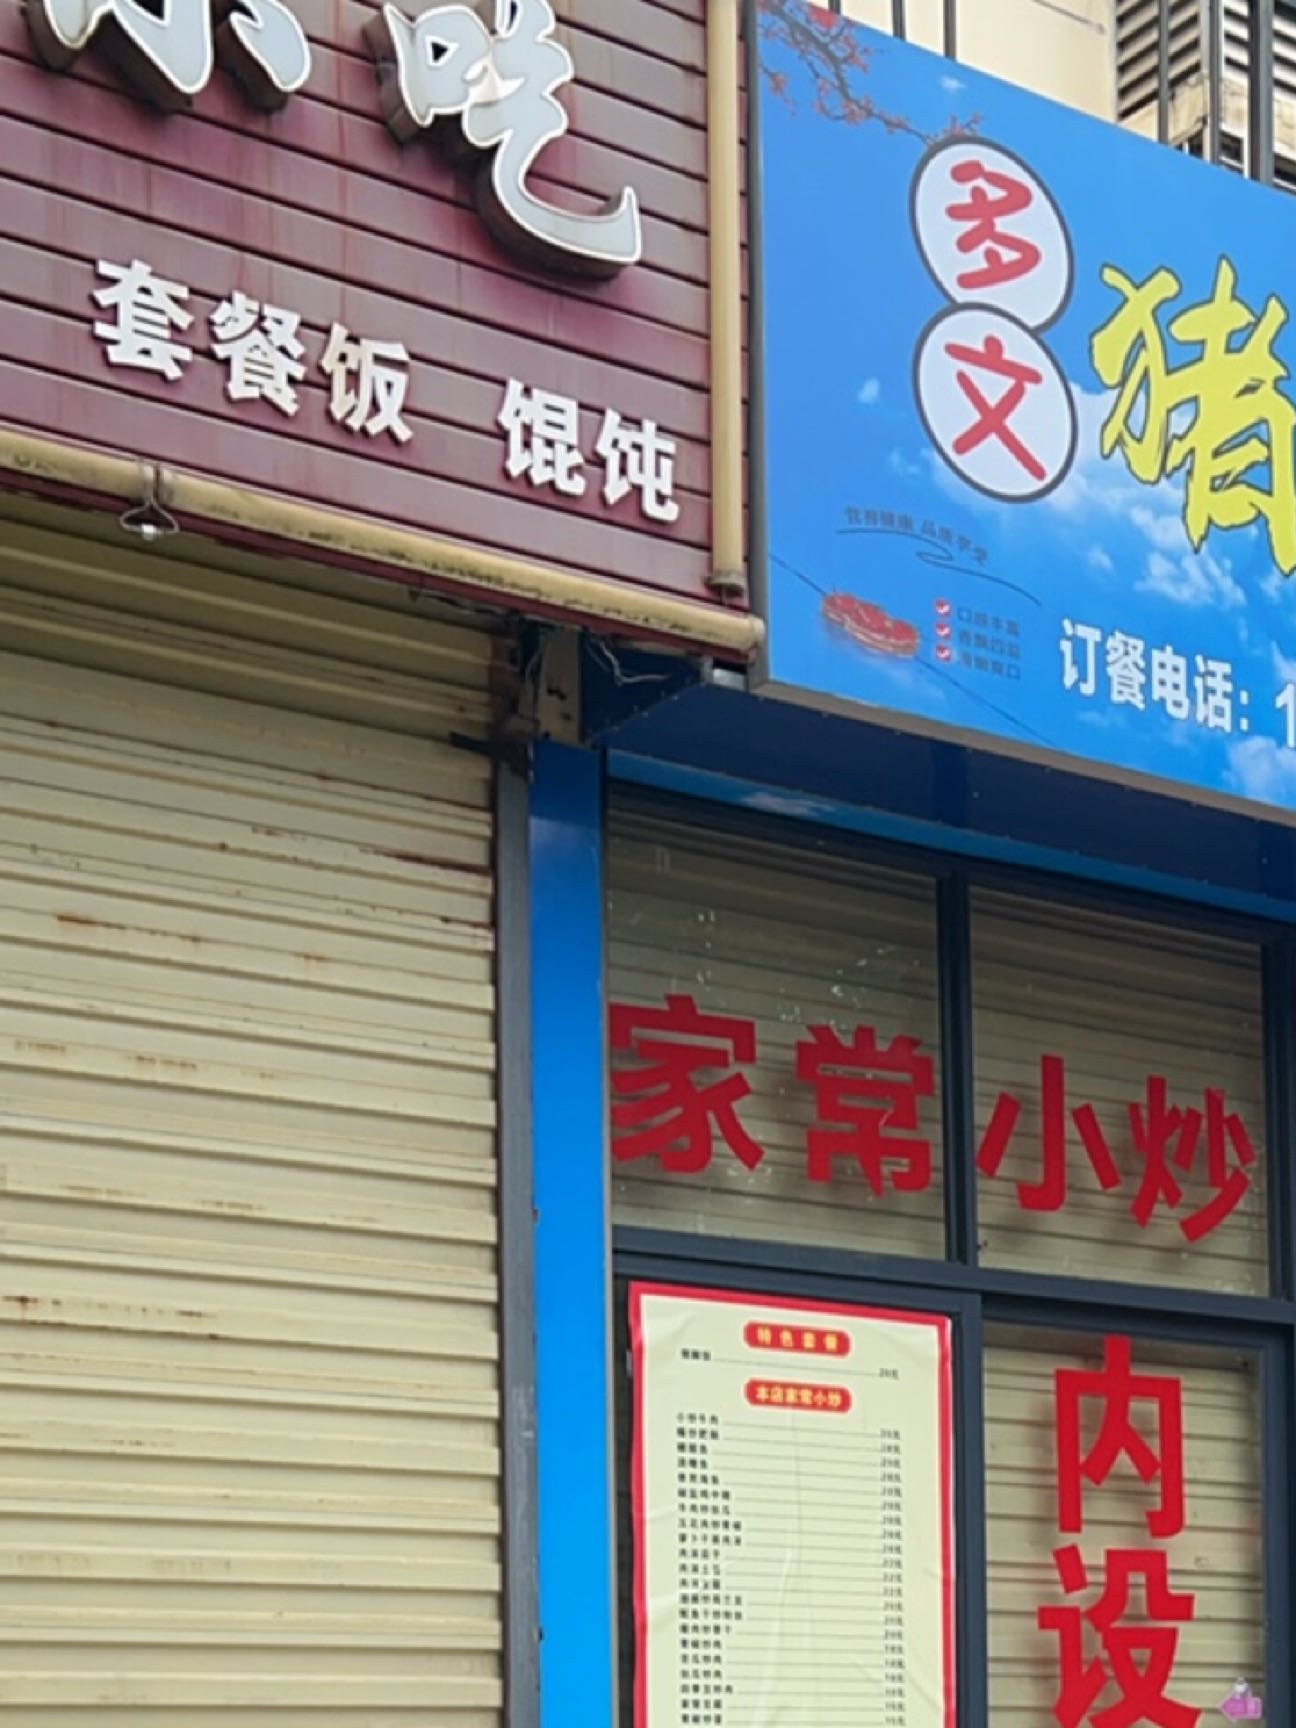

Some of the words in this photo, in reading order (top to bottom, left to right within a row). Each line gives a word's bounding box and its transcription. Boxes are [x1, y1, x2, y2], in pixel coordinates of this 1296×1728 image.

[93, 258, 414, 444] 套餐饭
[498, 378, 680, 522] 馄饨
[945, 158, 1048, 482] 多文
